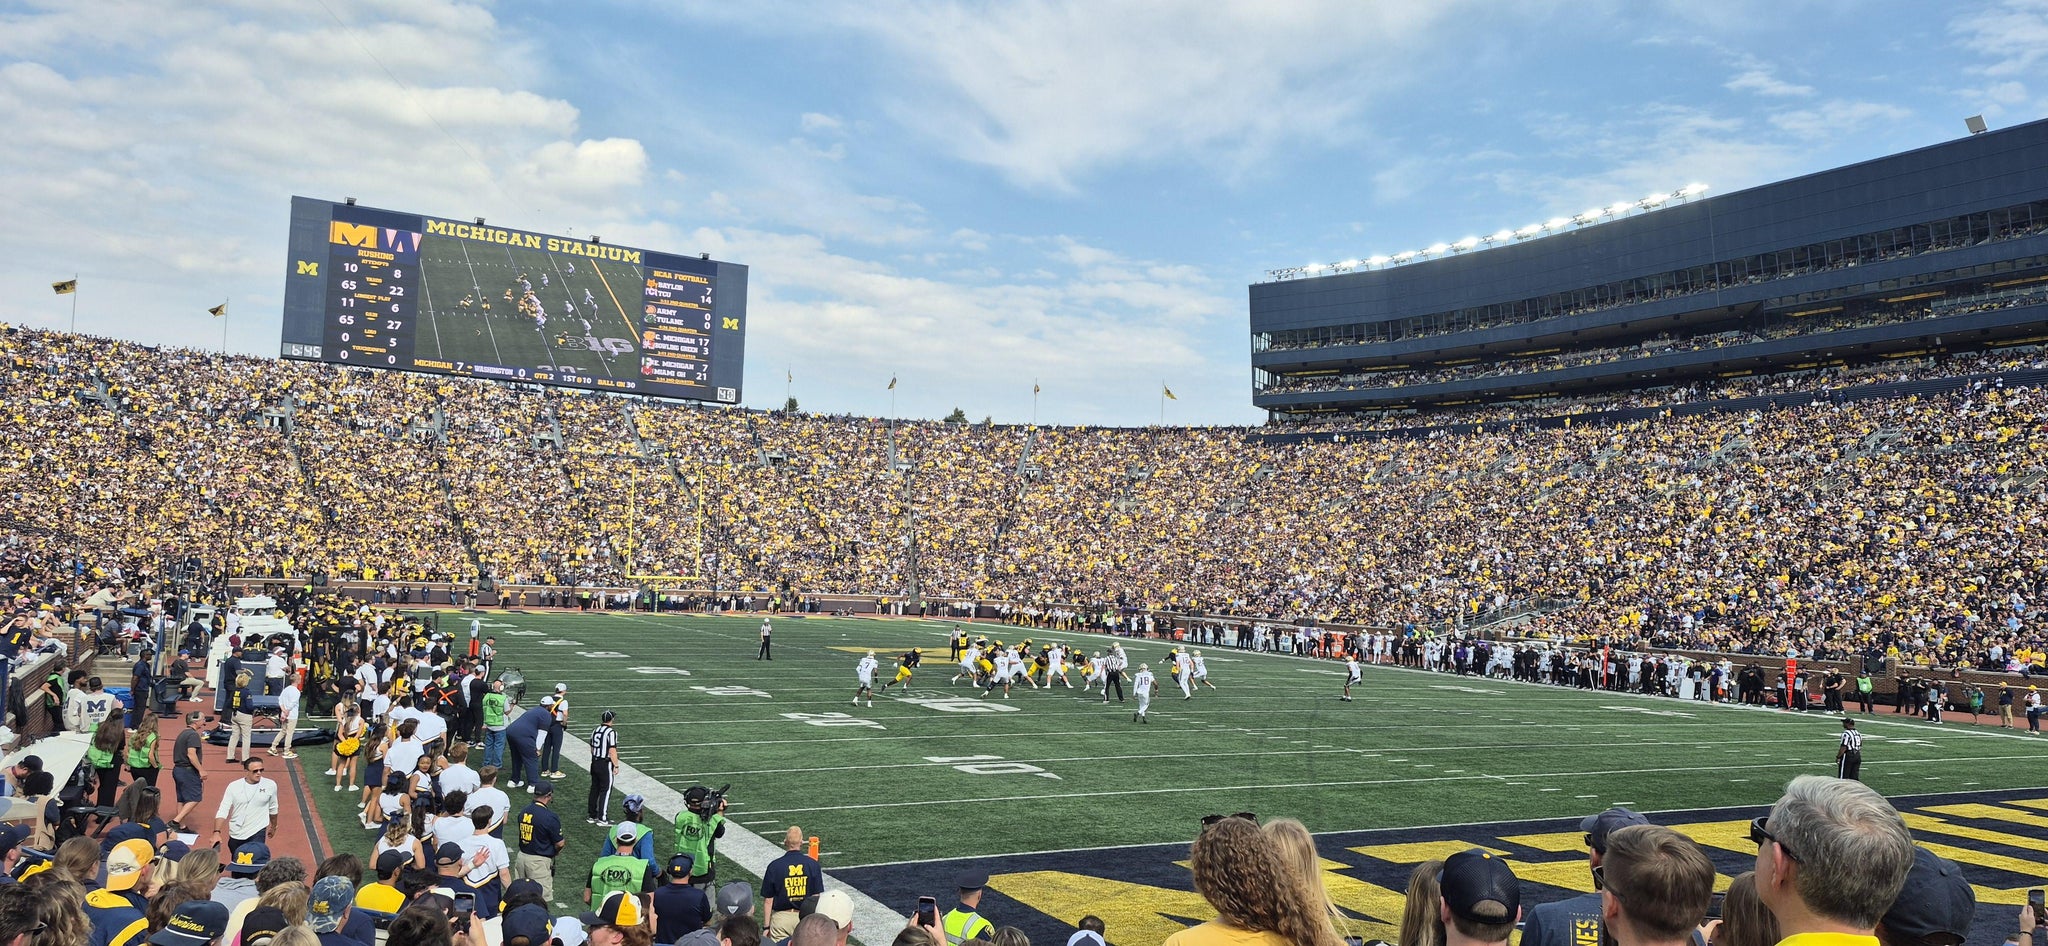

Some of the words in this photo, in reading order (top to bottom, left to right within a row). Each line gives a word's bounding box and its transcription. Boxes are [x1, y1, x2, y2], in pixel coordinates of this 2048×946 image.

[329, 221, 378, 249] M
[385, 228, 422, 252] W
[427, 219, 541, 249] MICHIGAN
[547, 238, 641, 264] STADIUM
[358, 249, 395, 261] RUSHING
[297, 260, 319, 276] M
[343, 263, 358, 273] 10
[393, 269, 402, 279] 8
[653, 270, 673, 279] NCAA
[674, 273, 708, 284] FOOTBALL
[341, 280, 357, 290] 65
[658, 281, 683, 291] BAYLOR
[389, 286, 404, 296] 22
[658, 290, 671, 298] TCU
[706, 287, 713, 296] 7
[341, 297, 355, 307] 11
[700, 295, 712, 304] 14
[391, 303, 400, 313] 6
[656, 307, 677, 316] ARMY
[338, 315, 355, 325] 65
[656, 316, 684, 326] TULANE
[704, 312, 711, 321] 0
[386, 320, 402, 330] 27
[704, 321, 711, 330] 0
[722, 317, 739, 330] M
[341, 332, 350, 342] 0
[389, 337, 397, 347] 5
[663, 334, 695, 344] MICHIGAN
[655, 342, 679, 351] BOWLING
[680, 344, 698, 353] GREEN
[698, 338, 709, 347] 17
[340, 350, 349, 360] 0
[703, 347, 709, 355] 3
[387, 355, 396, 365] 0
[662, 360, 694, 370] MICHIGAN
[653, 369, 675, 377] MIAMI
[702, 364, 708, 372] 7
[414, 358, 453, 369] MICHIGAN
[456, 362, 464, 371] 7
[474, 365, 513, 376] WASHINGTON
[518, 368, 526, 377] 0
[562, 374, 576, 383] 1ST
[582, 376, 592, 384] 10
[597, 379, 615, 387] BALL
[626, 381, 636, 389] 30
[696, 372, 707, 380] 21
[10, 632, 21, 645] 1
[865, 661, 870, 669] 7
[1139, 676, 1150, 686] 18
[87, 700, 106, 712] M
[593, 733, 600, 747] S
[523, 812, 533, 824] M
[520, 823, 534, 833] EVENT
[686, 825, 701, 835] FOX
[520, 831, 532, 841] TEAM
[237, 851, 254, 865] M
[607, 869, 626, 880] FOX
[789, 864, 804, 877] M
[784, 876, 808, 888] EVENT
[786, 886, 807, 898] TEAM
